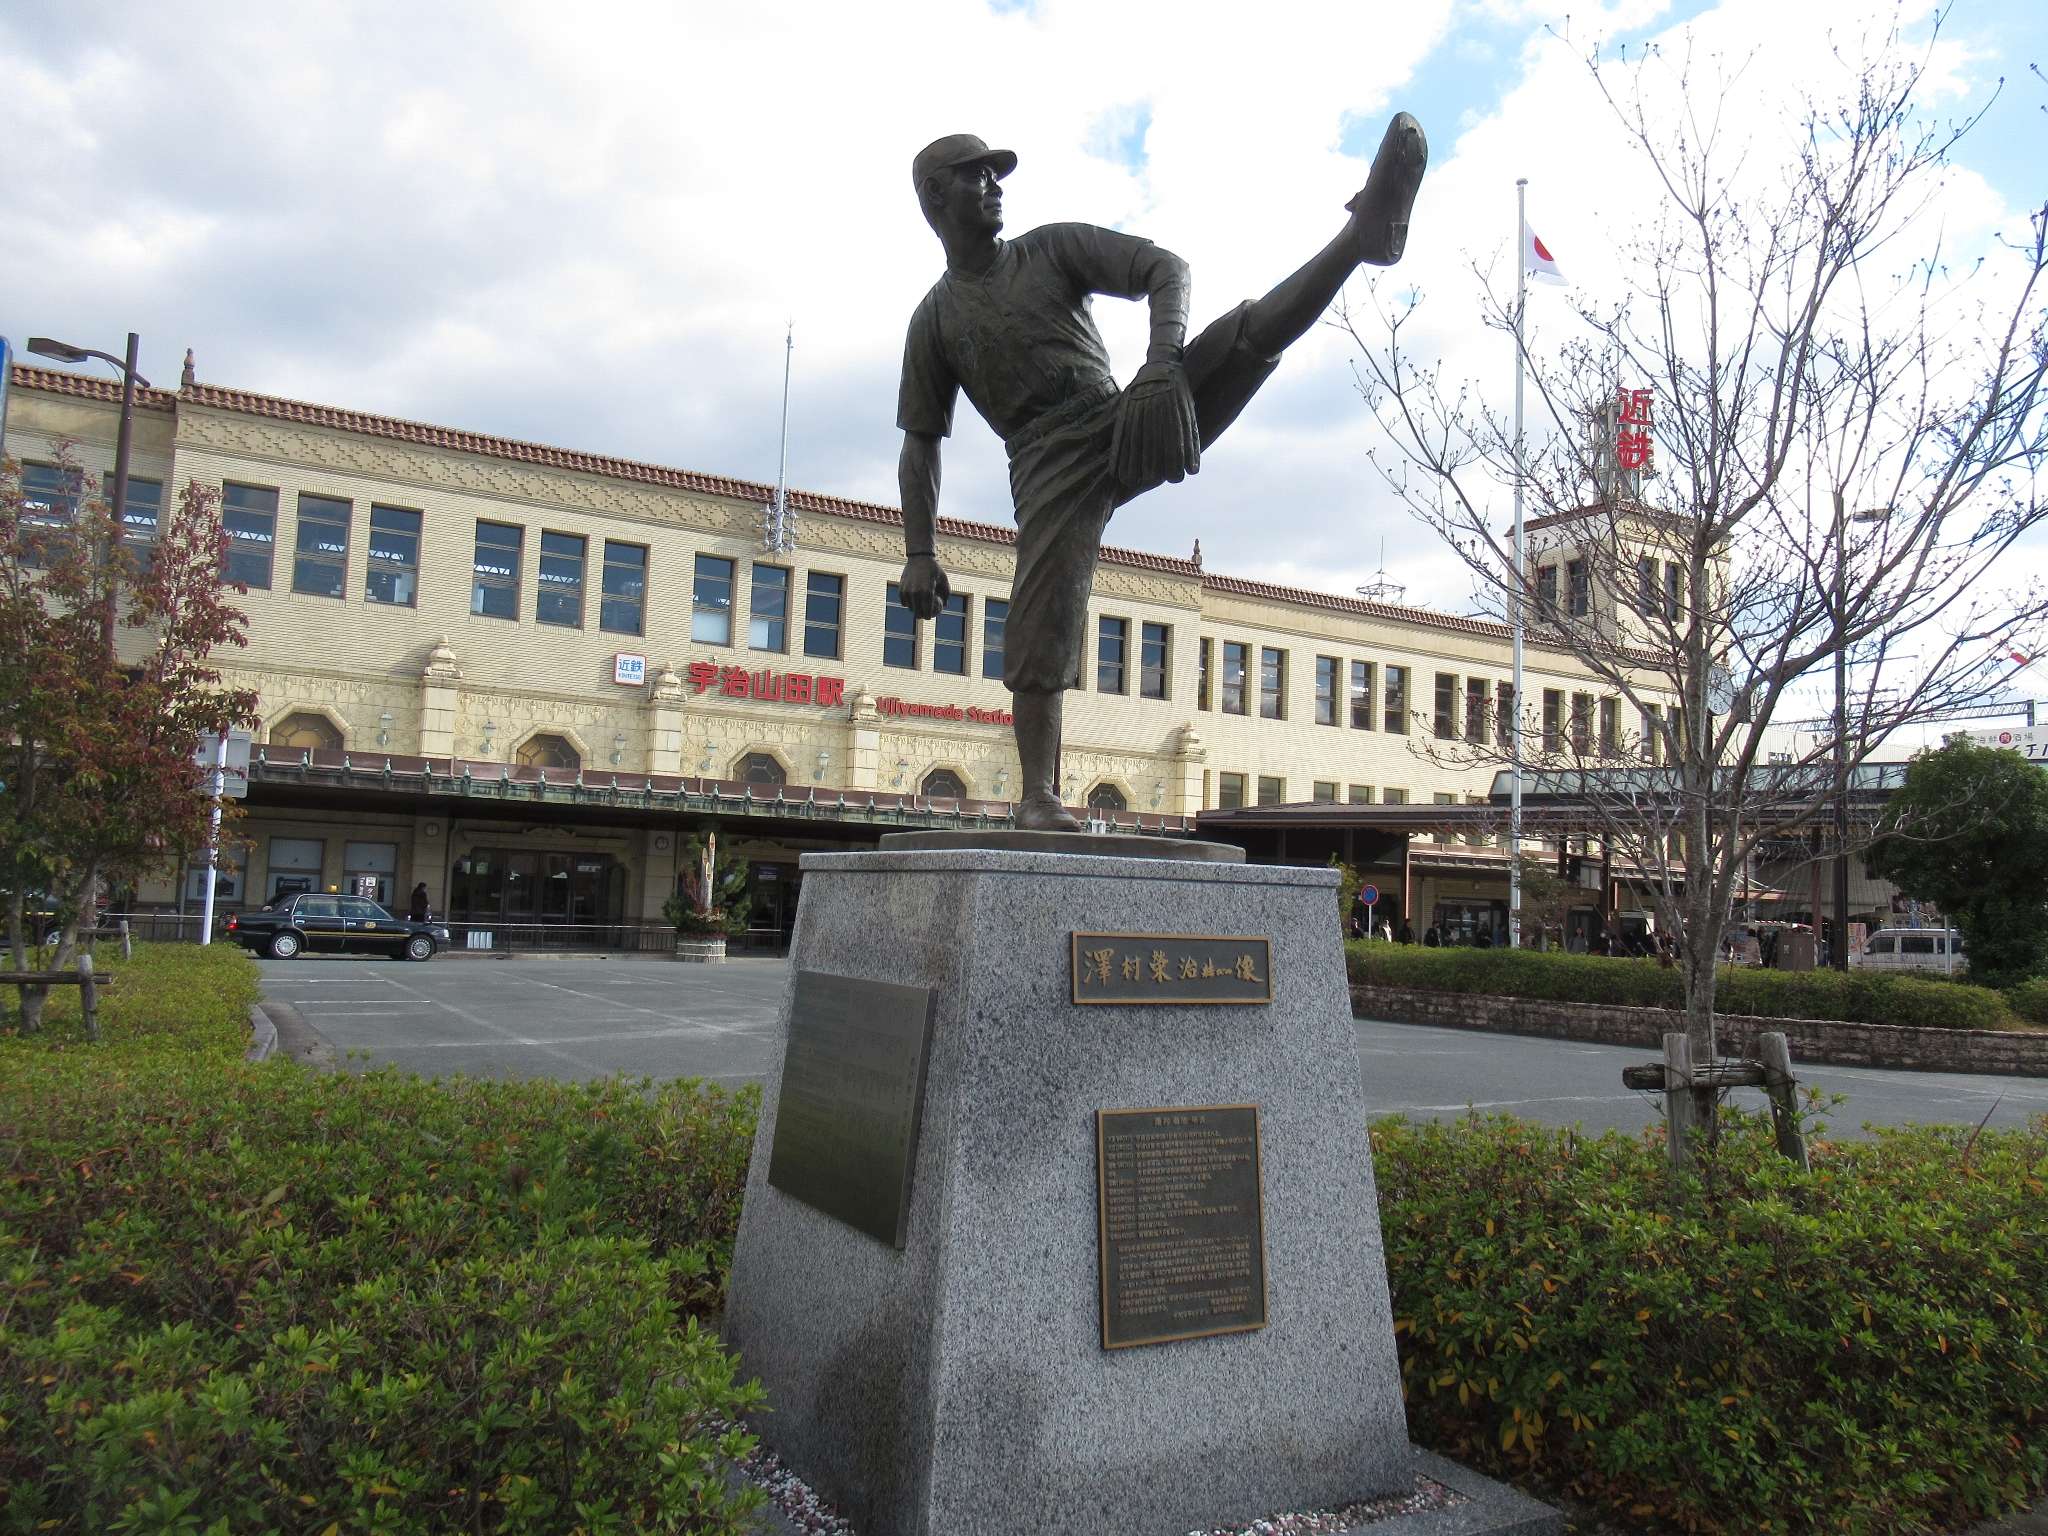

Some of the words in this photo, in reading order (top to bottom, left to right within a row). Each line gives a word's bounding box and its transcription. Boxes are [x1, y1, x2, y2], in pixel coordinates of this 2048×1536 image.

[1616, 386, 1654, 480] 近鉄
[618, 658, 643, 672] 近鉄
[688, 661, 845, 706] 宇治山田駅
[967, 705, 1013, 726] Statio
